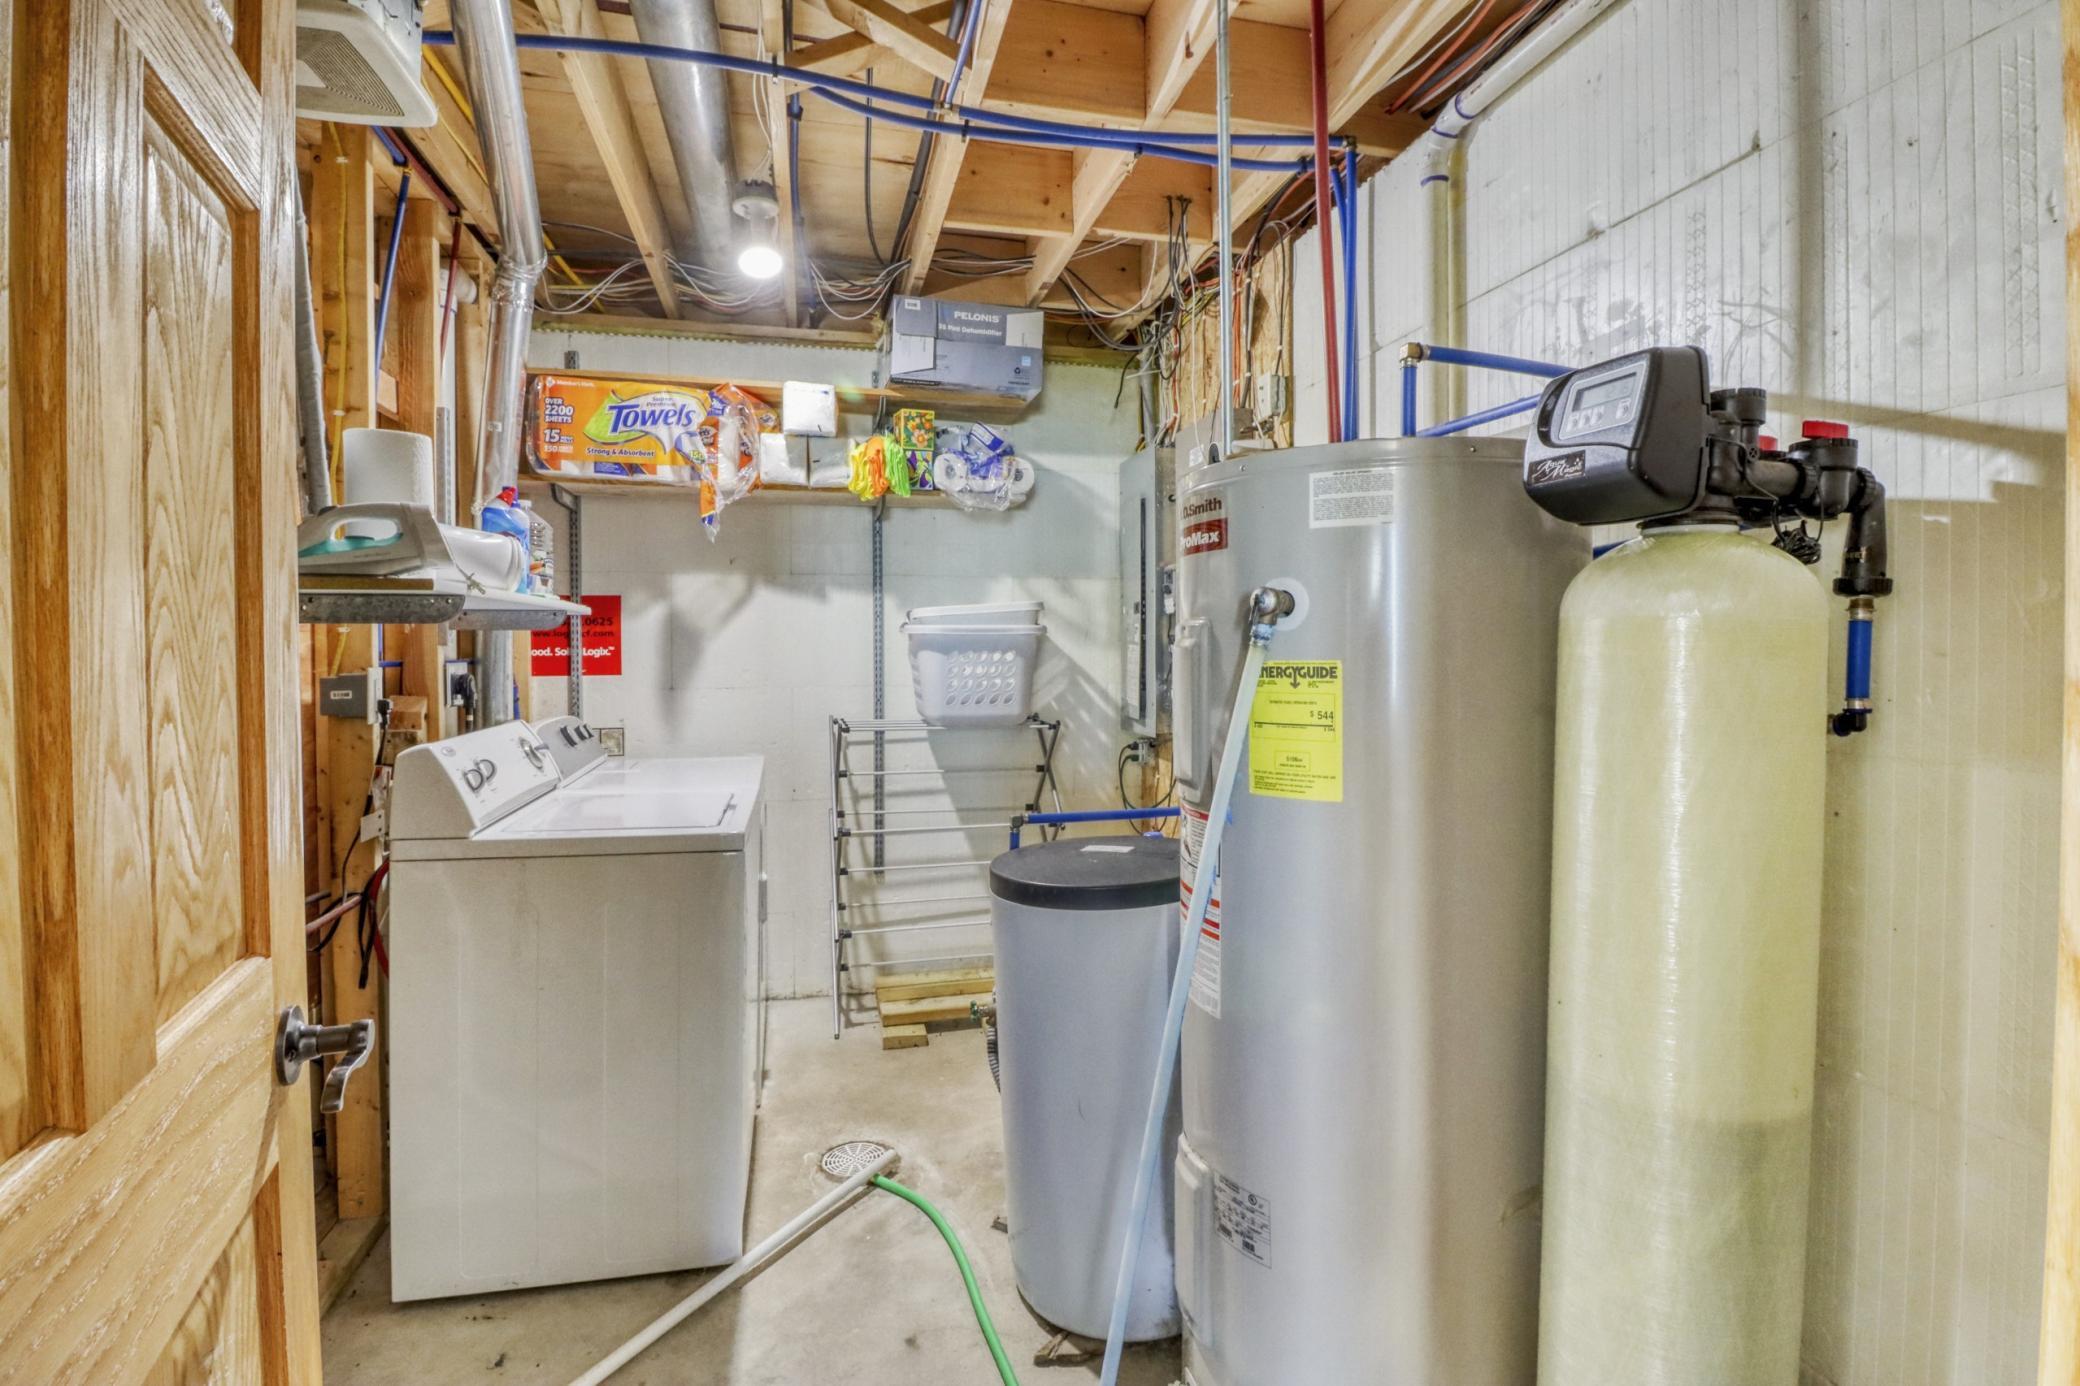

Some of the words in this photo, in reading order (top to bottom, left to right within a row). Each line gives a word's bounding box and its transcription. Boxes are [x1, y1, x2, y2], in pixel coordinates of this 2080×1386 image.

[954, 310, 1000, 323] PELONIS
[962, 326, 1002, 337] Dehumidifier
[545, 397, 563, 405] OVER
[545, 404, 574, 416] 2200
[545, 415, 572, 424] SHEETS
[607, 403, 697, 435] Towels
[544, 428, 560, 443] 15
[586, 447, 610, 457] Strong
[611, 448, 617, 456] &
[618, 448, 655, 457] Absorbent
[1260, 666, 1338, 679] NERGYGUIDE
[1317, 710, 1334, 720] 544
